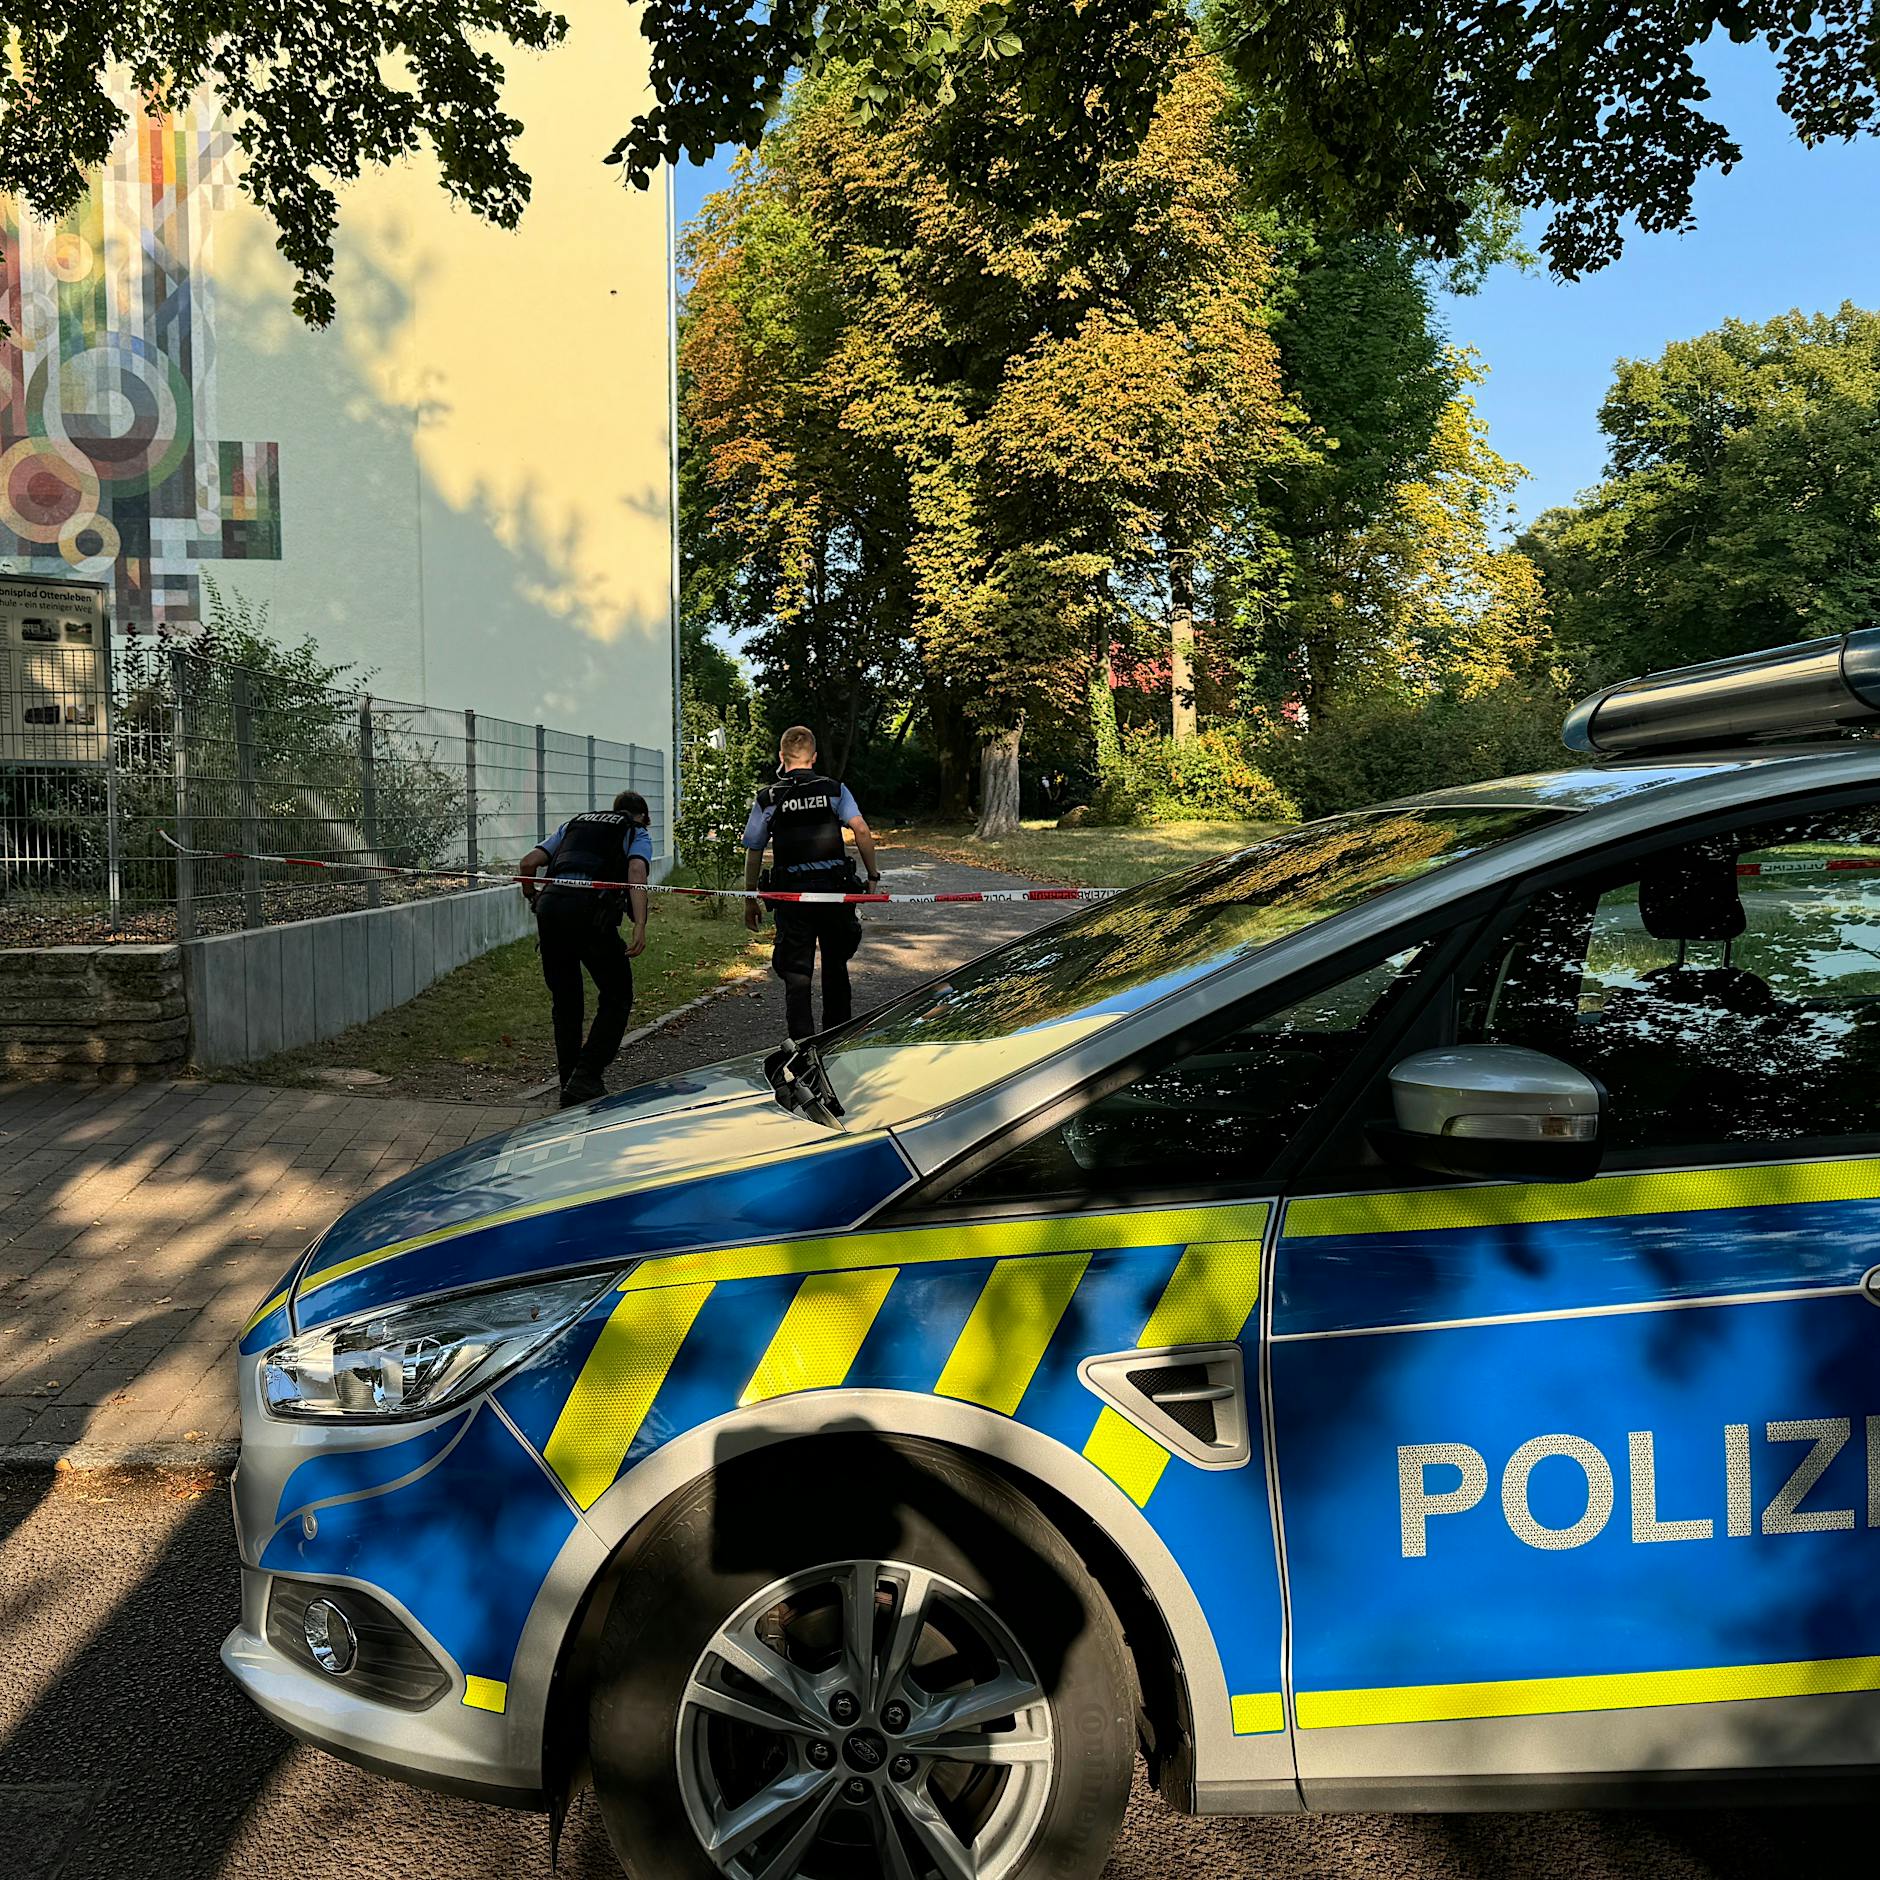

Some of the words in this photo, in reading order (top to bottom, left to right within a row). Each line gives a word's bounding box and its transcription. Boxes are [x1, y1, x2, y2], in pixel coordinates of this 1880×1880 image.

[40, 590, 92, 602] Ottersleben
[782, 795, 828, 813] POLIZEI
[577, 813, 624, 825] POLIZEI
[1397, 1415, 1880, 1558] POLIZ
